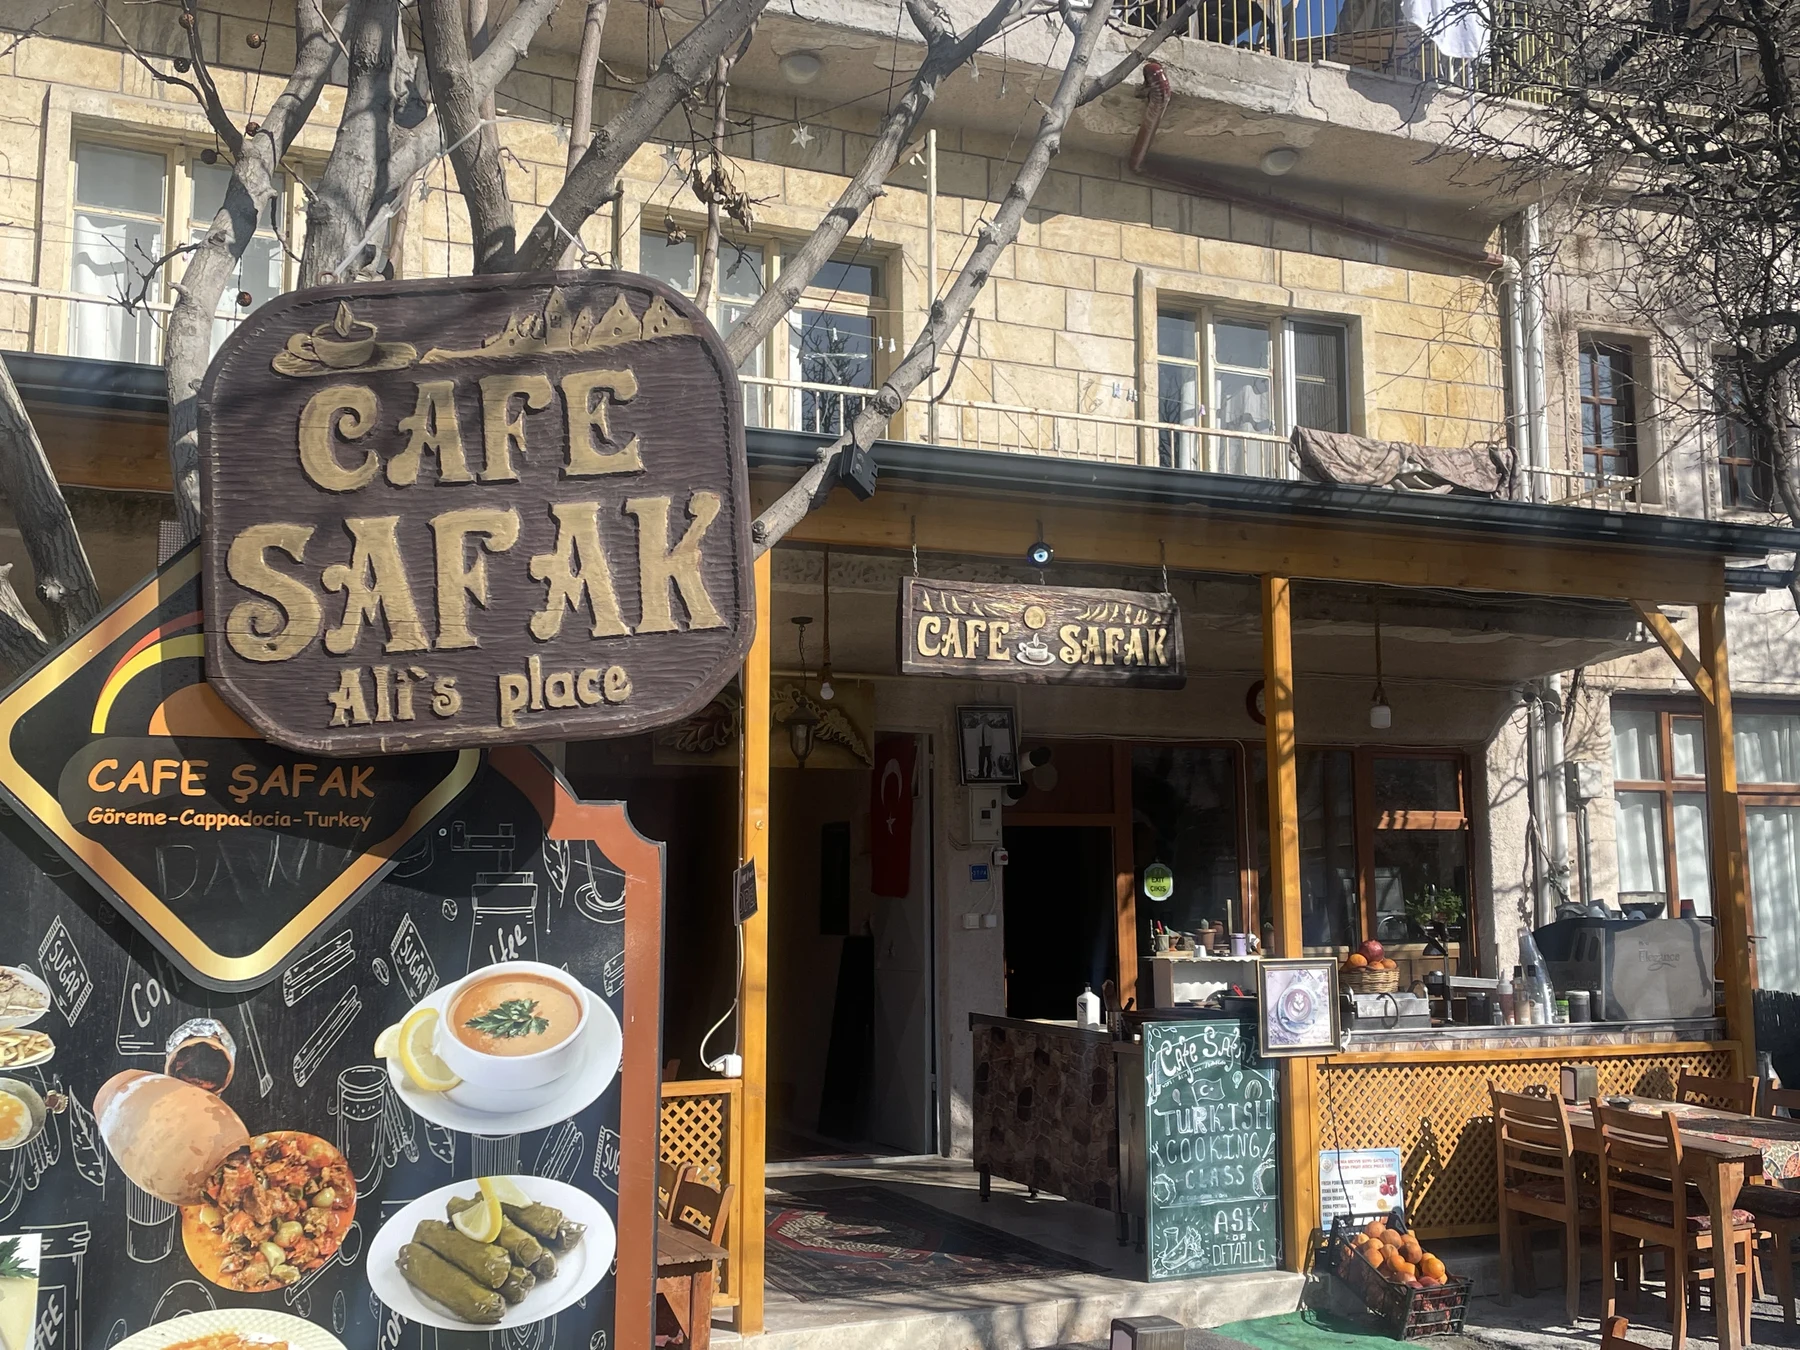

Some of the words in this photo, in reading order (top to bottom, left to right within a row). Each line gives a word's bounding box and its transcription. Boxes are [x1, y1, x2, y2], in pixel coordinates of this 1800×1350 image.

[299, 368, 645, 493] CAFE
[225, 491, 729, 663] SAFAK
[916, 615, 1011, 661] CAFE
[1058, 624, 1168, 667] SAFAK
[499, 654, 632, 729] place
[87, 758, 210, 797] CAFE
[227, 763, 376, 804] ŞAFAK
[87, 806, 373, 832] Göreme-Cappadocia-Turkey
[48, 940, 81, 1003] SUGAR
[399, 935, 429, 995] SUGAR
[1154, 1098, 1273, 1136] TURKISH
[1166, 1132, 1261, 1165] COOKING
[1185, 1165, 1245, 1189] CLASS
[1214, 1204, 1261, 1235] ASK
[1212, 1239, 1267, 1267] DETAILS
